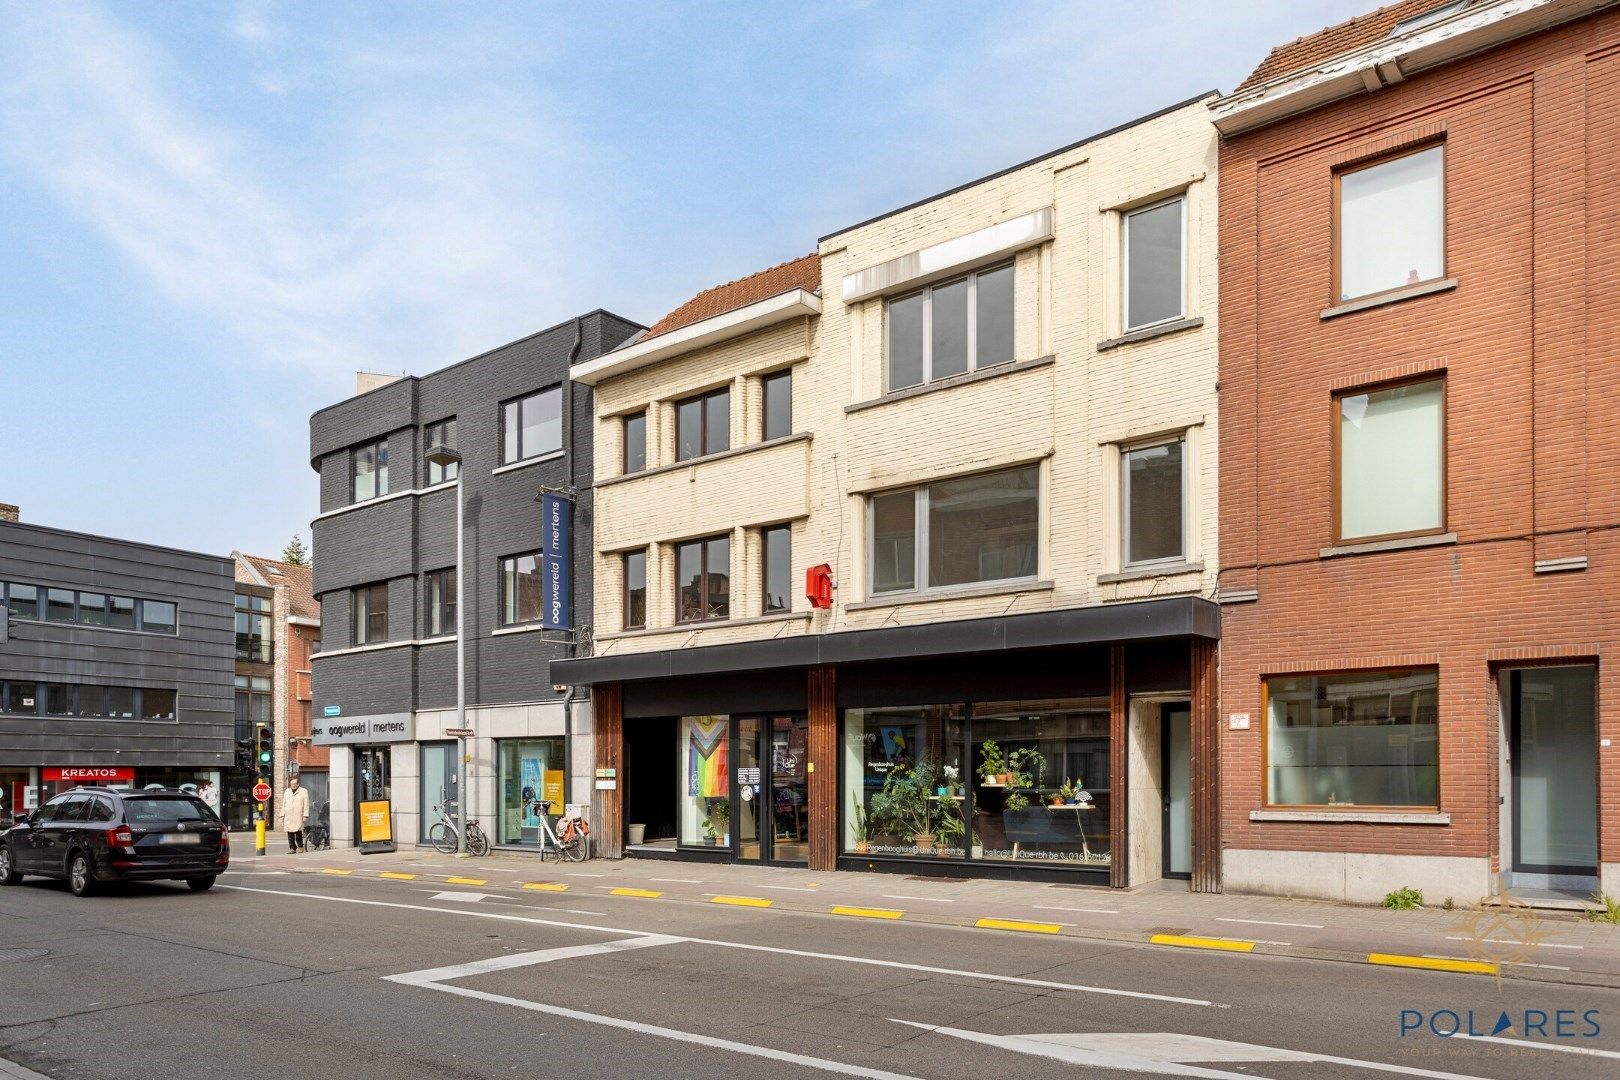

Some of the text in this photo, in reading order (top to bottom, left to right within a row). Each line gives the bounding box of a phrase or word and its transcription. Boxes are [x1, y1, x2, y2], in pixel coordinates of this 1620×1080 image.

[551, 501, 561, 624] oogwereld mertens
[328, 722, 365, 737] oogwereld
[372, 721, 405, 733] mertens
[61, 768, 117, 779] KREATOS
[254, 788, 271, 796] STOP
